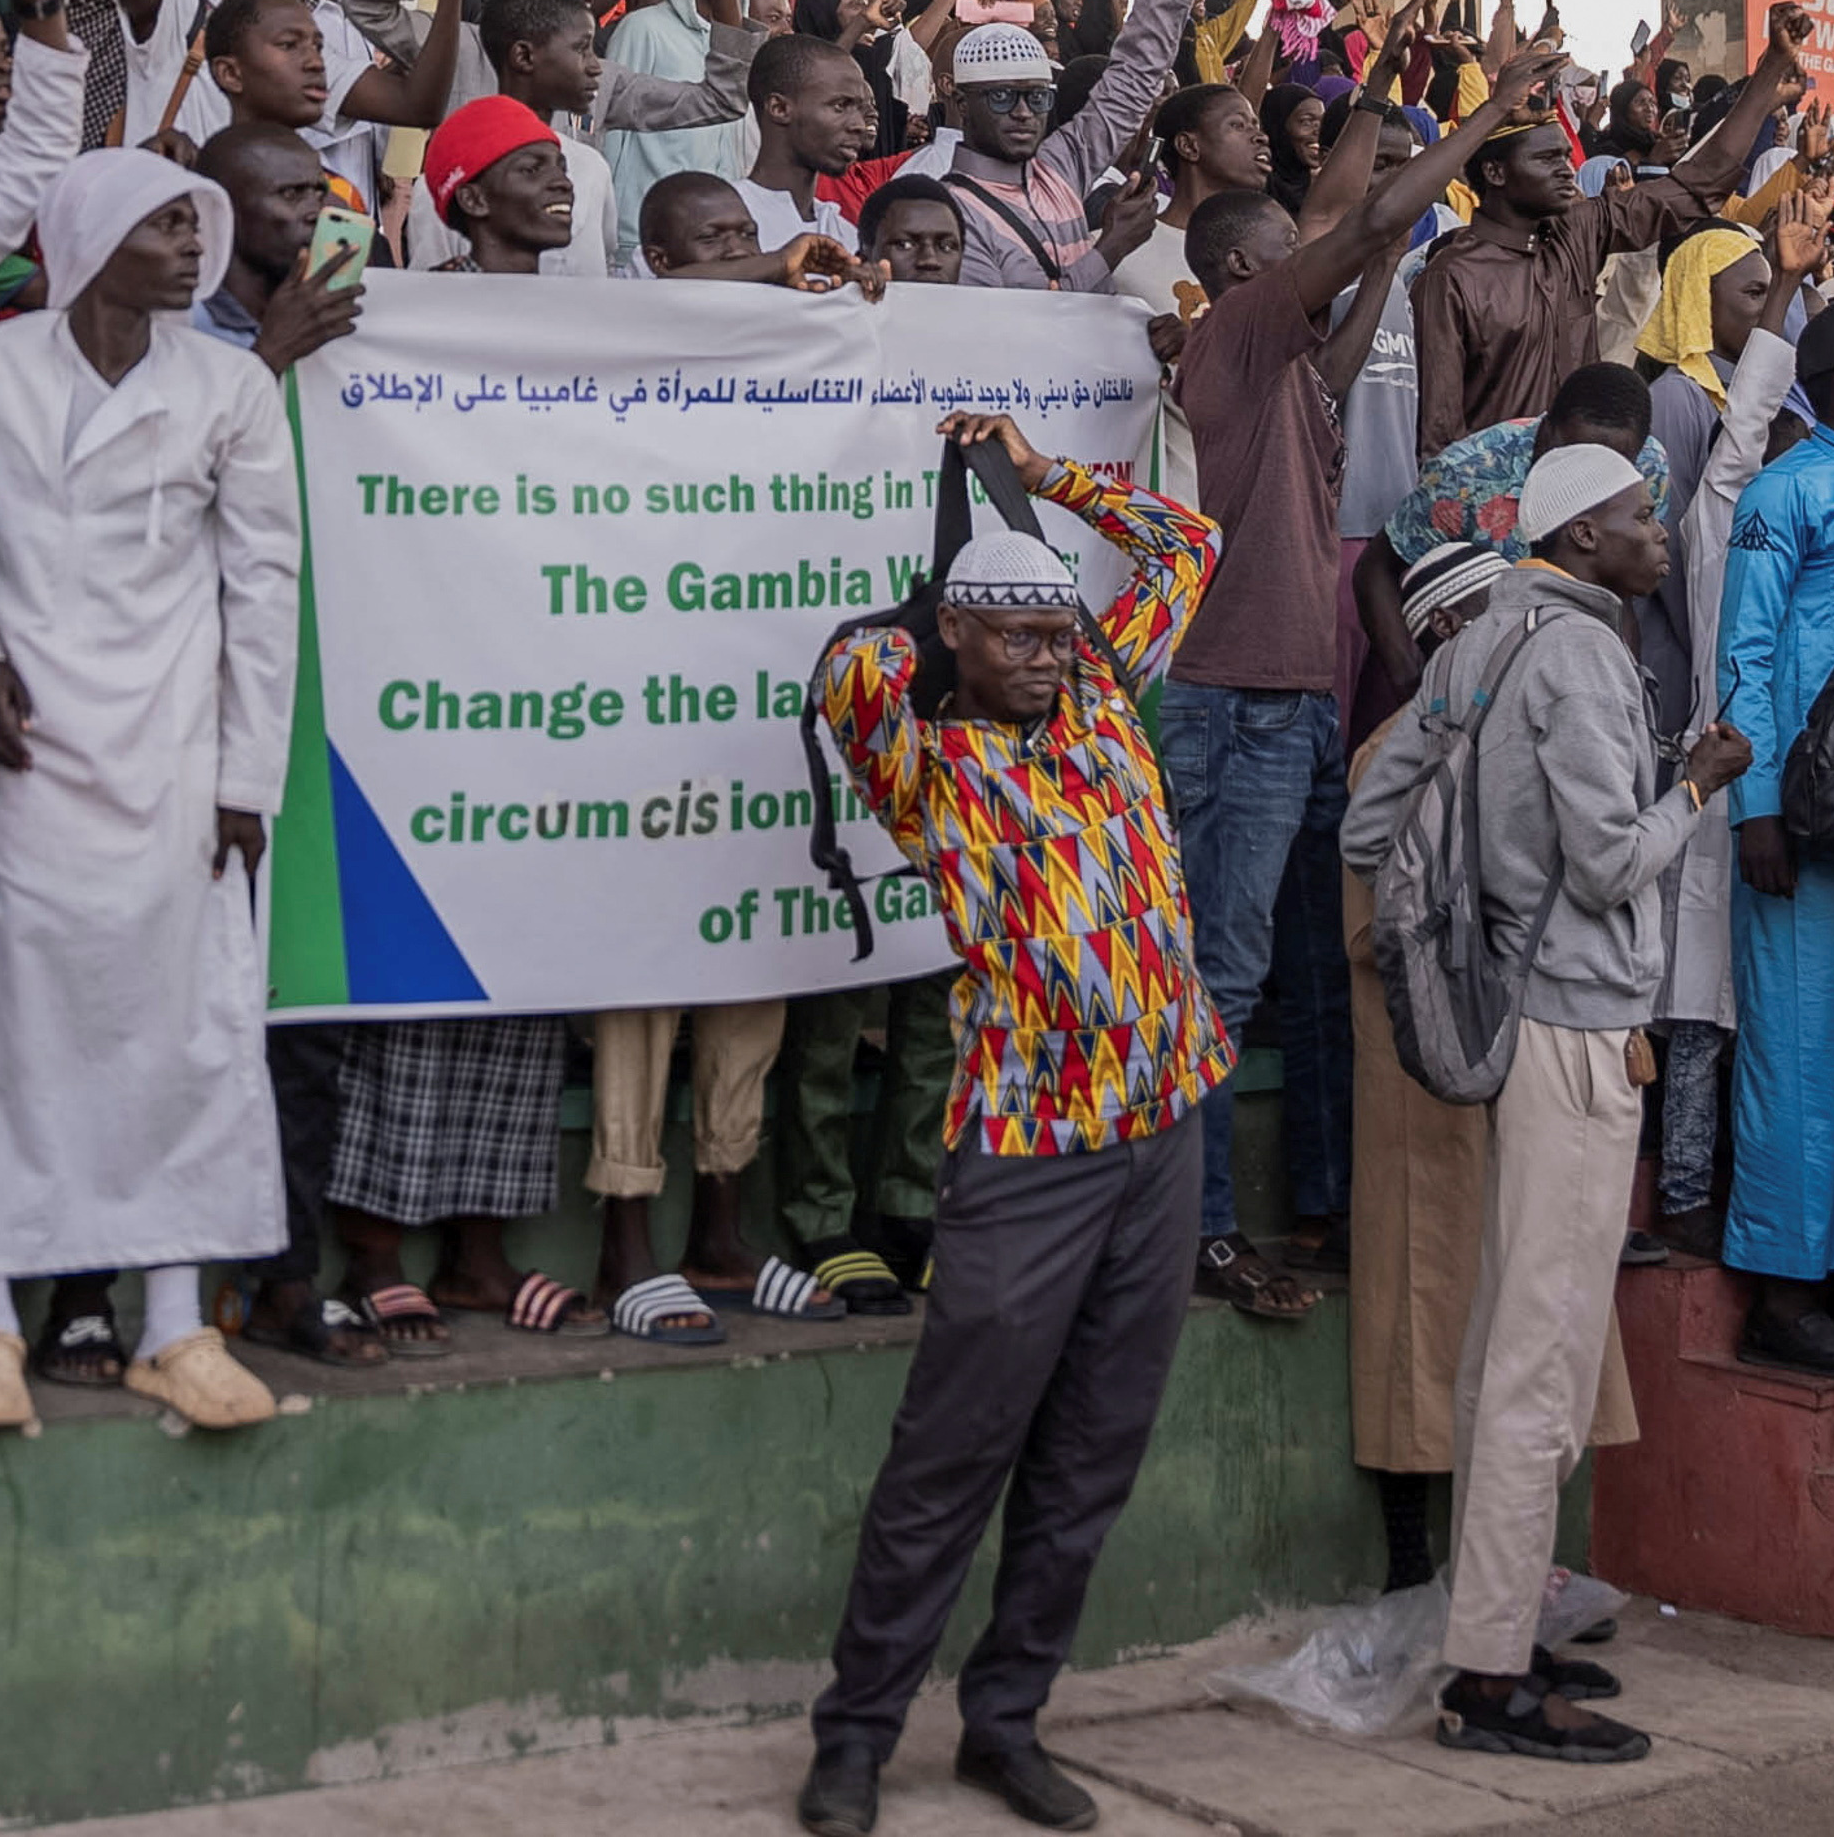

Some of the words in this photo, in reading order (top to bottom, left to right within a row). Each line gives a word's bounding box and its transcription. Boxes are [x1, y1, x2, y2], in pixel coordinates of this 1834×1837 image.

[340, 373, 444, 412] الإطلاق
[454, 374, 508, 412] على
[516, 375, 599, 412] غامبيا
[609, 376, 649, 423] في
[656, 368, 737, 412] للمرأة
[743, 377, 864, 412] التناسلية
[870, 369, 927, 407] الأعضاء
[930, 376, 974, 412] تشويه
[976, 384, 1010, 412] يوجد
[1013, 377, 1032, 411] ولا
[1071, 379, 1091, 410] حق
[1091, 377, 1135, 411] فالختان
[356, 473, 501, 516] There
[516, 473, 558, 516] is
[572, 484, 632, 516] no
[646, 473, 756, 515] such
[769, 471, 876, 521] thing
[884, 470, 914, 510] in
[541, 564, 649, 616] The
[667, 557, 873, 613] Gambia
[378, 680, 626, 741] Change
[642, 674, 739, 726] the
[756, 669, 808, 720] la
[699, 890, 760, 945] of
[774, 885, 857, 937] The
